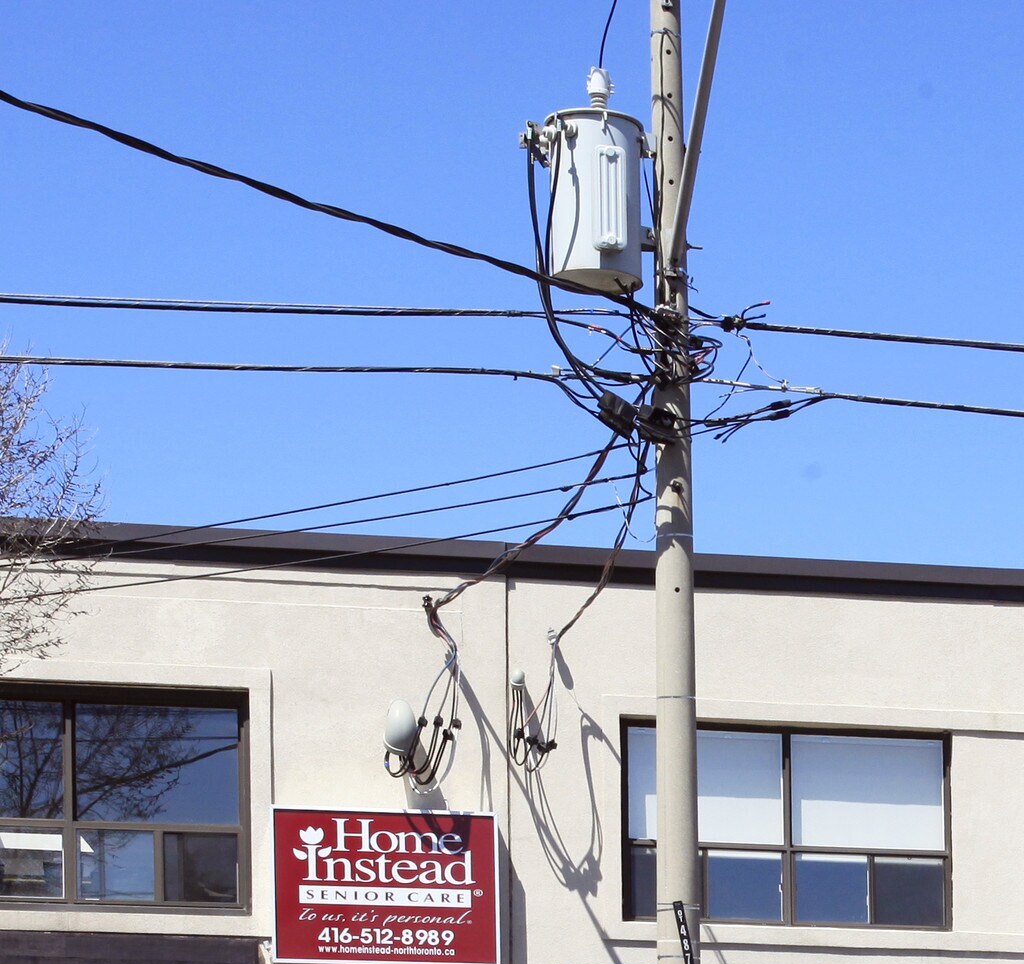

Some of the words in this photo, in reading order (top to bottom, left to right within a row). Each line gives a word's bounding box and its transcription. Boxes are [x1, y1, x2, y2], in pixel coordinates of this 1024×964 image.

[331, 817, 464, 855] Home
[302, 844, 476, 885] Instead
[306, 889, 395, 903] SENIOR
[407, 891, 465, 905] CARE
[299, 907, 317, 921] To
[351, 909, 379, 922] it's
[383, 910, 472, 926] personal
[318, 927, 455, 946] 416-512-8989
[318, 945, 456, 956] www.homeinstead-northtoronto.ca
